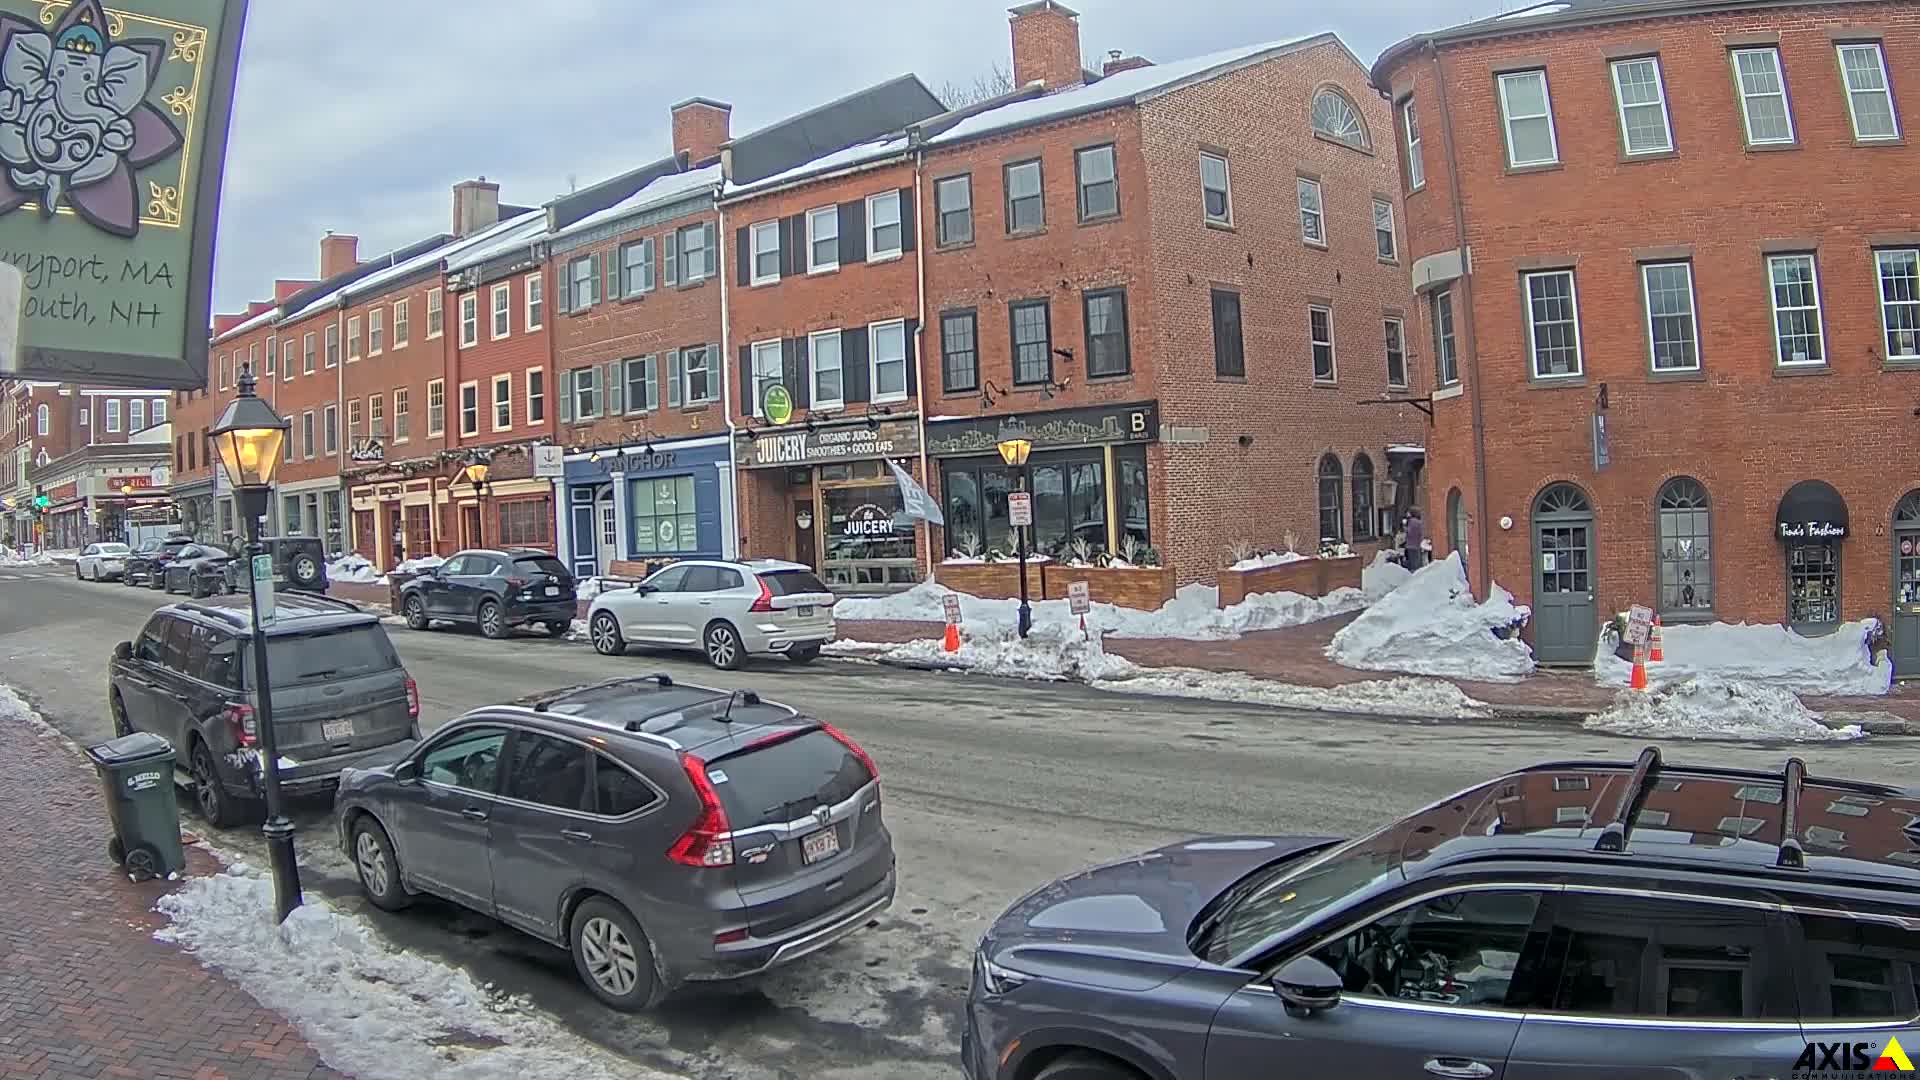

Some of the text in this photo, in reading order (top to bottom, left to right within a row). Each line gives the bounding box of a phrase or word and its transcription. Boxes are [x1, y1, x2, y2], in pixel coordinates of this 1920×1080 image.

[120, 259, 174, 289] MA
[110, 301, 163, 328] NH
[819, 431, 851, 445] ORGANIC
[756, 433, 807, 463] JUICERY
[806, 440, 894, 458] SMOOTHIES GOOD EATS
[843, 519, 894, 535] JUICERY
[1780, 522, 1805, 537] Tina's
